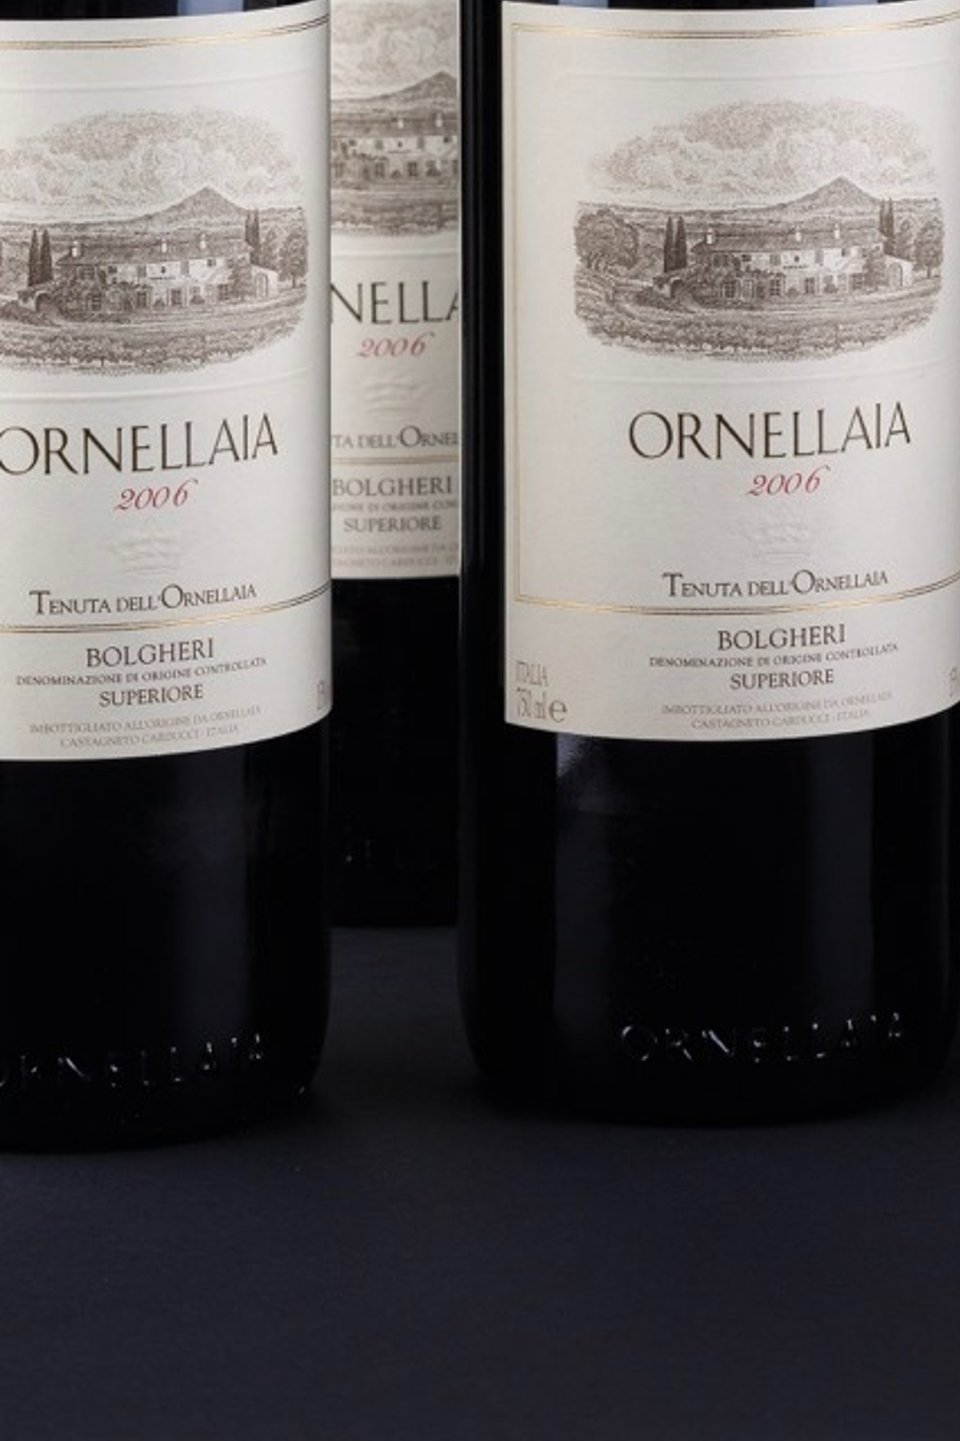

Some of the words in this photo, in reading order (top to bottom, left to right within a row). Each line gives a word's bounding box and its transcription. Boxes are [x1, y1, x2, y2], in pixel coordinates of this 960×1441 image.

[357, 332, 435, 357] 2006
[629, 401, 911, 459] ORNELLAIA
[0, 413, 278, 475] ORNELLAIA
[332, 476, 452, 497] BOLGHERI
[748, 465, 830, 496] 2006
[114, 479, 199, 510] 2006
[343, 515, 441, 533] SUPERIORE
[662, 572, 742, 597] TENUTA
[29, 590, 111, 615] TENUTA
[718, 624, 846, 651] BOLGHERI
[86, 638, 214, 667] BOLGHERI
[16, 674, 122, 686] DENOMINAZIONE
[141, 669, 191, 682] ORIGINE
[195, 658, 266, 677] CONTROLLATA
[730, 668, 834, 690] SUPERIORE
[99, 684, 203, 708] SUPERIORE
